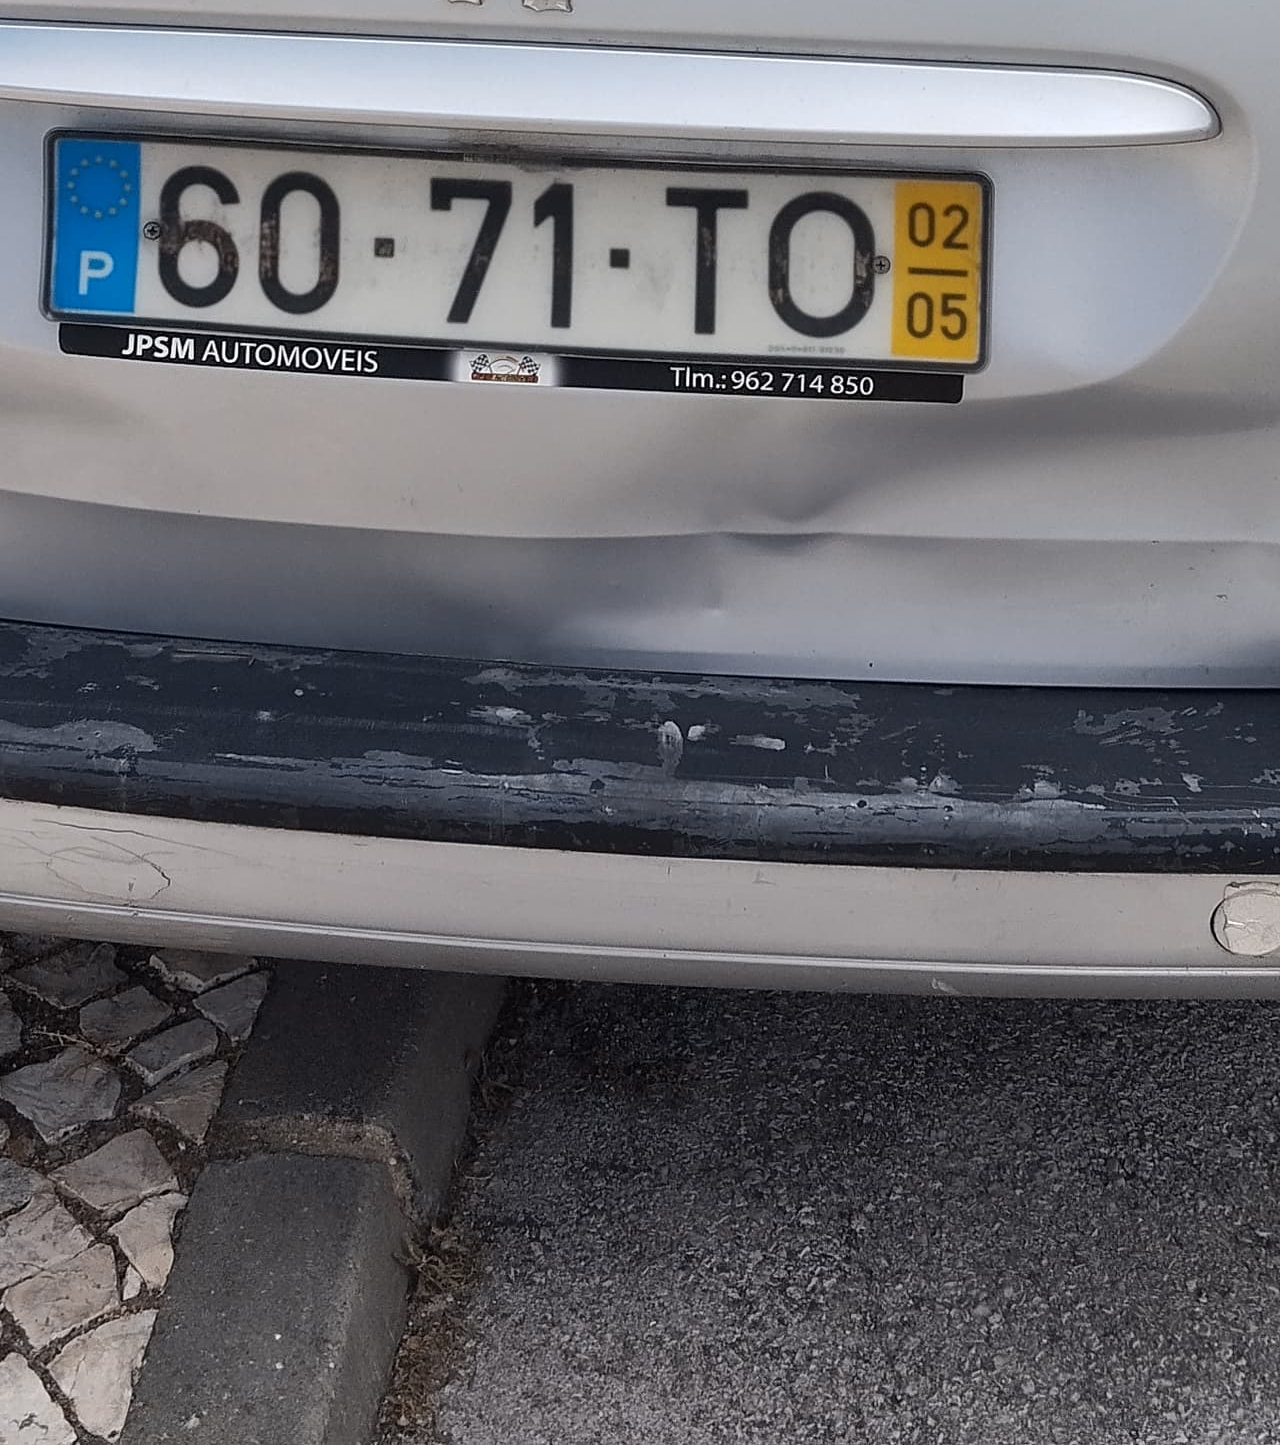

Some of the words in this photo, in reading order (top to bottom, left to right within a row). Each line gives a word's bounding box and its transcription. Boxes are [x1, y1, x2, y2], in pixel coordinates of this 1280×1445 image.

[908, 201, 970, 251] 02
[78, 249, 115, 296] P
[906, 290, 968, 341] 05
[122, 333, 195, 361] JPSM
[202, 341, 379, 374] AUTOMOVEIS
[781, 372, 824, 394] 714
[830, 374, 874, 396] 850
